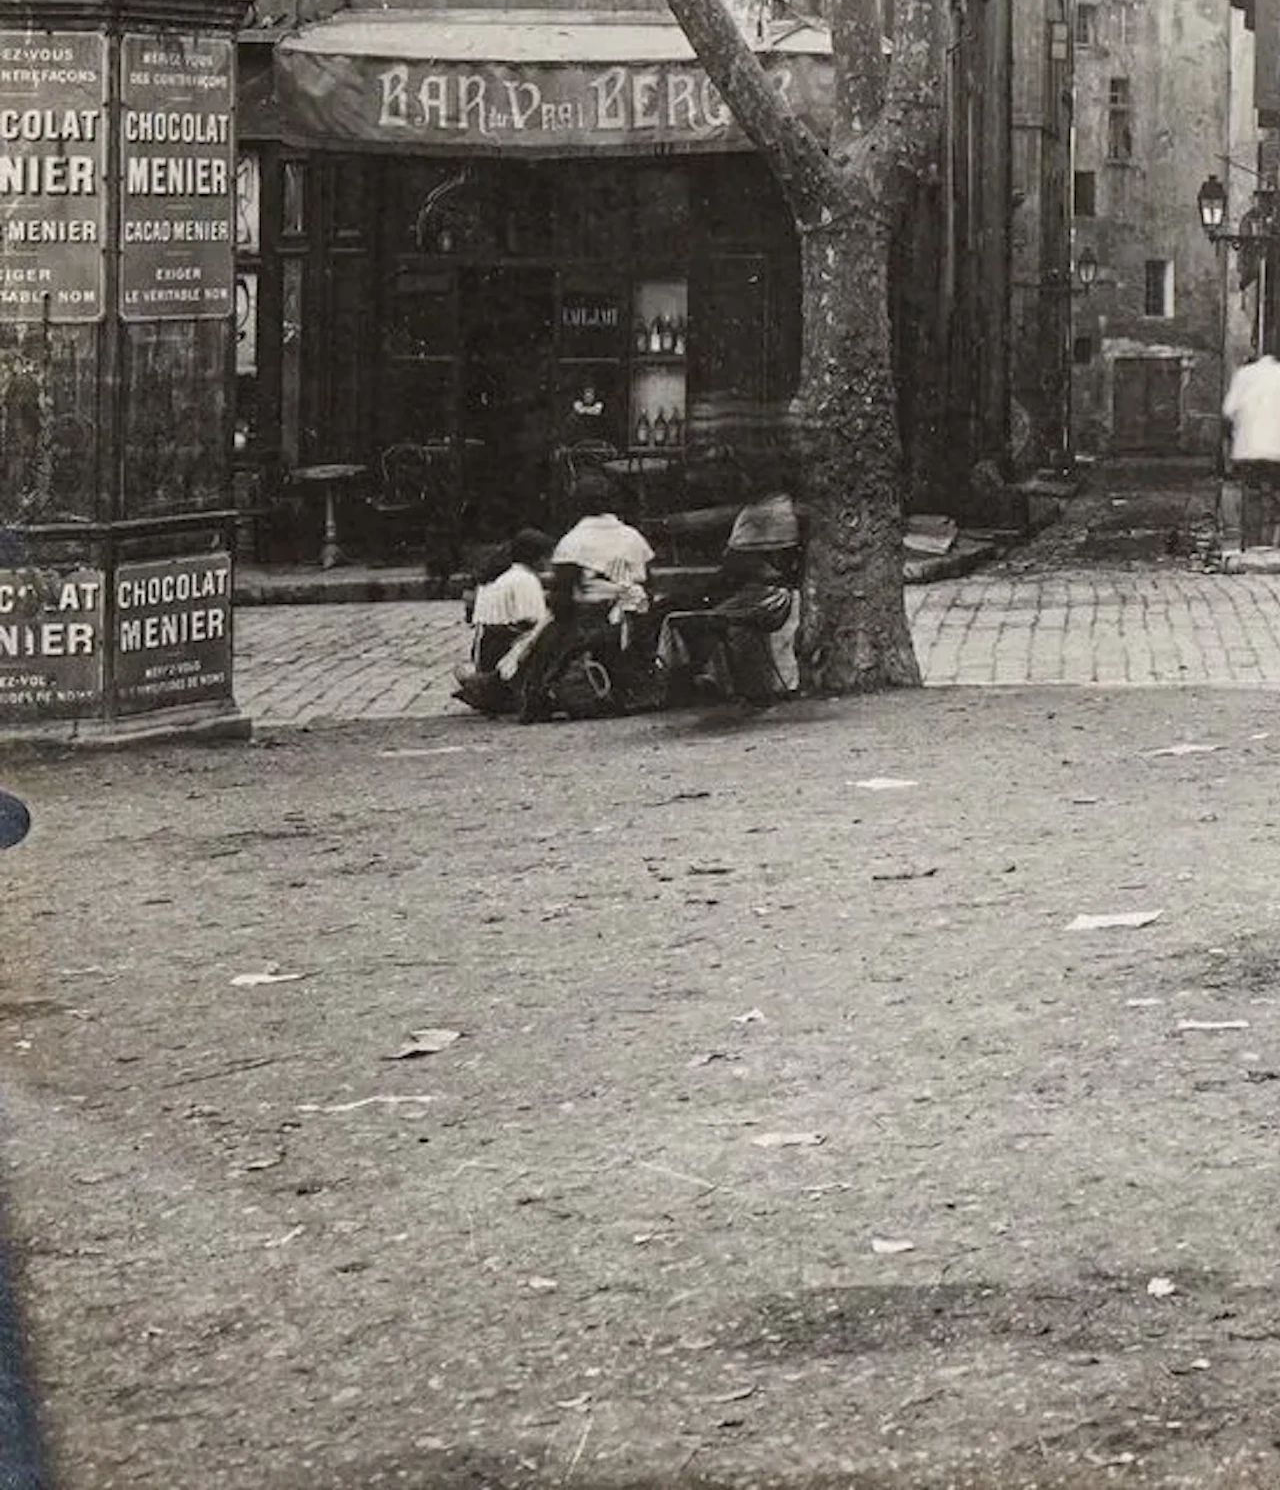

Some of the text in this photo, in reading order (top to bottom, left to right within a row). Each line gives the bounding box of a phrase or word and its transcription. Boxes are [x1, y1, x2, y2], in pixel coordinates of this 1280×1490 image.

[376, 62, 499, 137] BAR
[590, 65, 792, 139] BERGR
[1, 109, 100, 143] COLAT
[126, 111, 230, 144] CHOCOLAT
[127, 156, 228, 196] MENIER
[8, 220, 98, 242] MENIER
[124, 220, 229, 242] CACAO MENIER
[58, 290, 95, 303] NOM
[124, 290, 139, 304] LE
[117, 567, 228, 610] CHOCOLAT
[119, 607, 225, 654] MENIER
